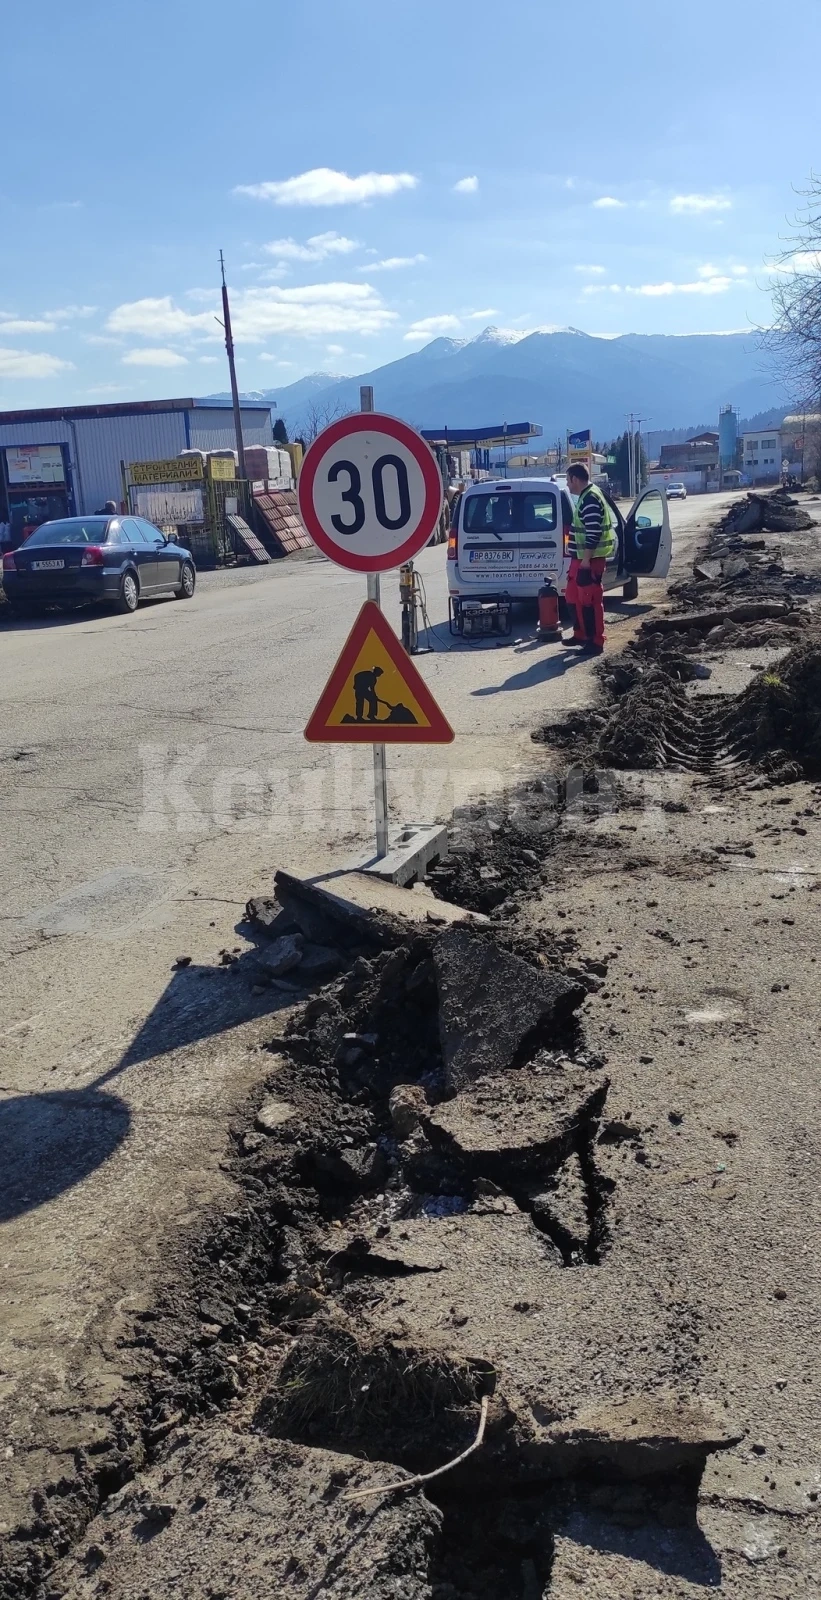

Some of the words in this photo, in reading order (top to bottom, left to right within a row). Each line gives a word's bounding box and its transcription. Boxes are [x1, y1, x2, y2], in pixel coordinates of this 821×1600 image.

[133, 460, 198, 472] СТРОИТЕЛНИ
[133, 470, 193, 482] МАТЕРИАЛИ
[327, 453, 412, 536] 30
[484, 551, 501, 560] 8376
